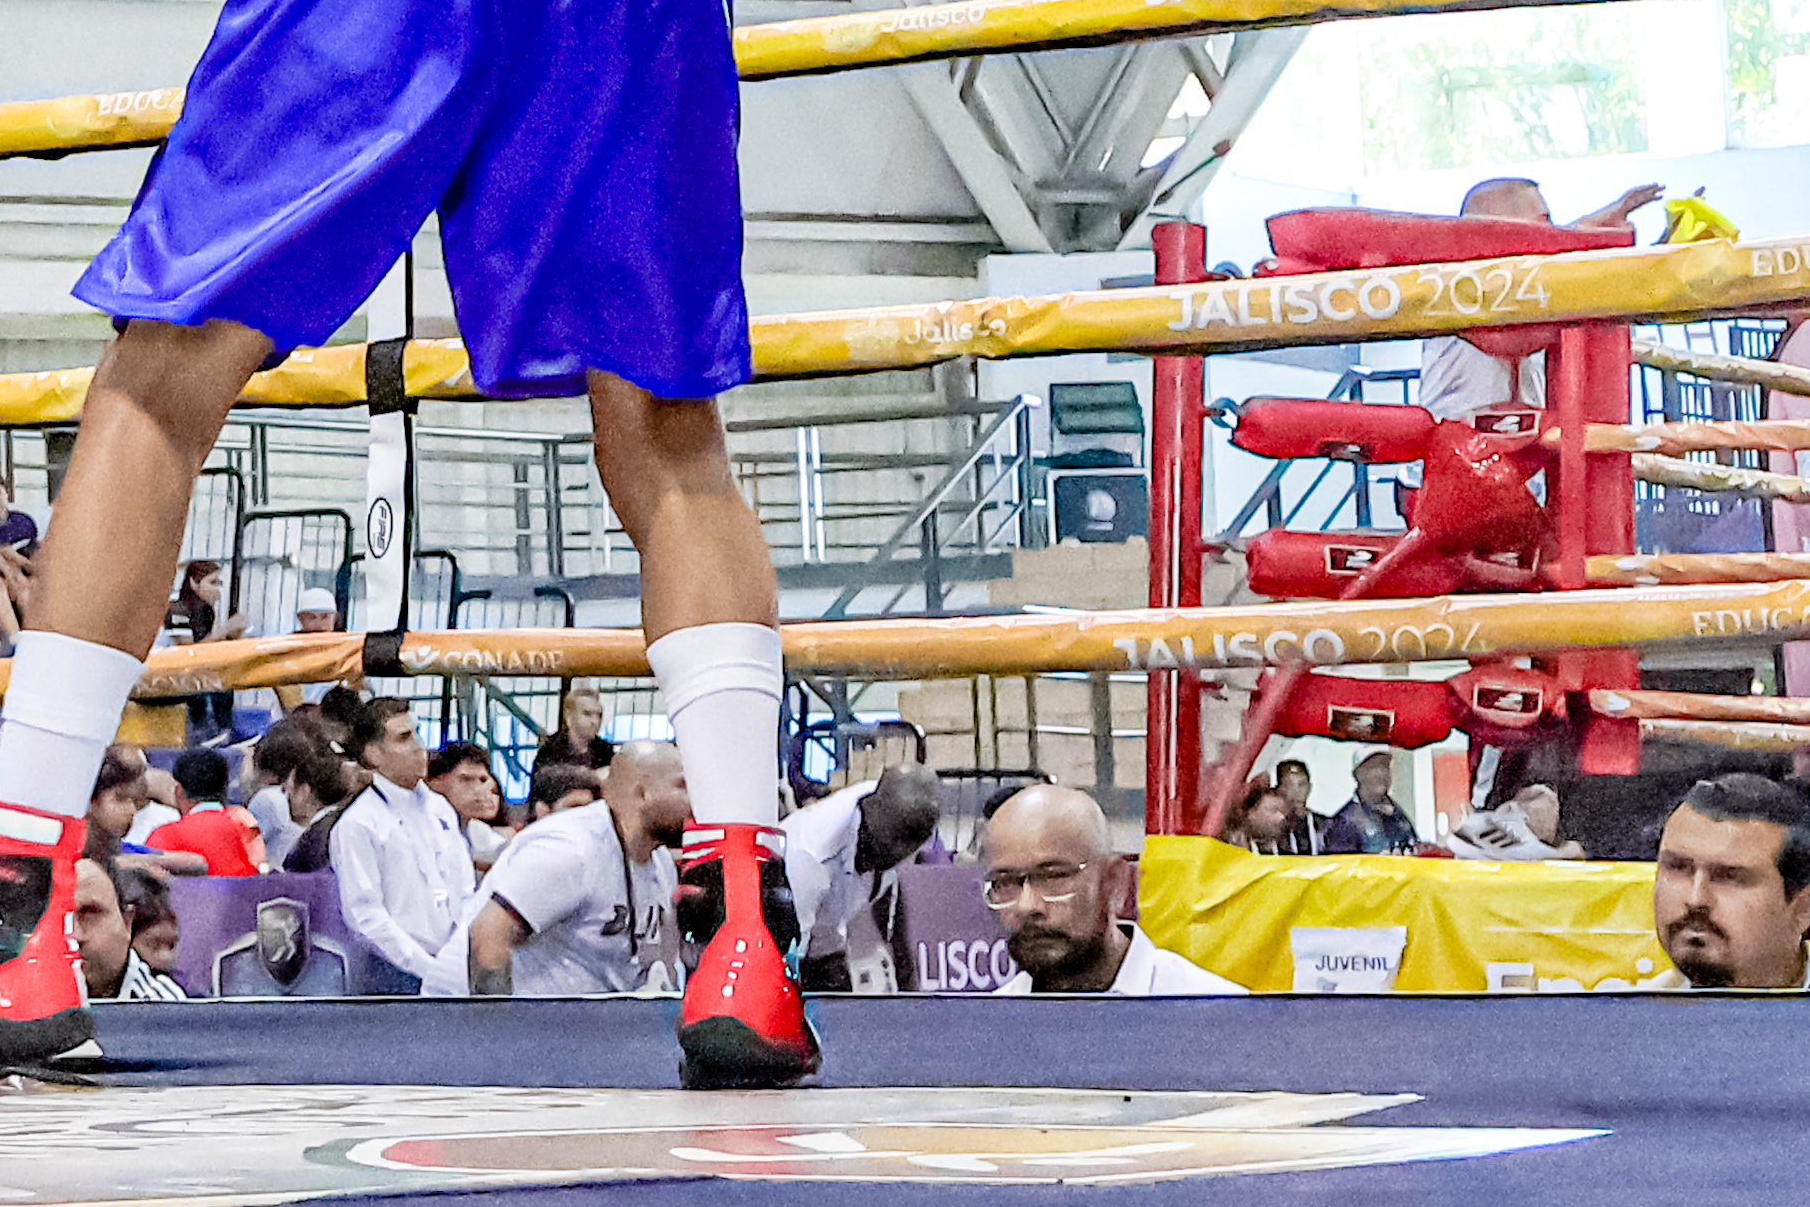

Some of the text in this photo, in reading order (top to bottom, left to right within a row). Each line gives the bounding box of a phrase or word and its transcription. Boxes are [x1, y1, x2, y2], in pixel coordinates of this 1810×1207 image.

[880, 5, 988, 33] Jalisco
[1166, 262, 1551, 332] JALISCO 2024
[1112, 627, 1345, 671] JALISCO
[1314, 954, 1389, 972] JUVENIL
